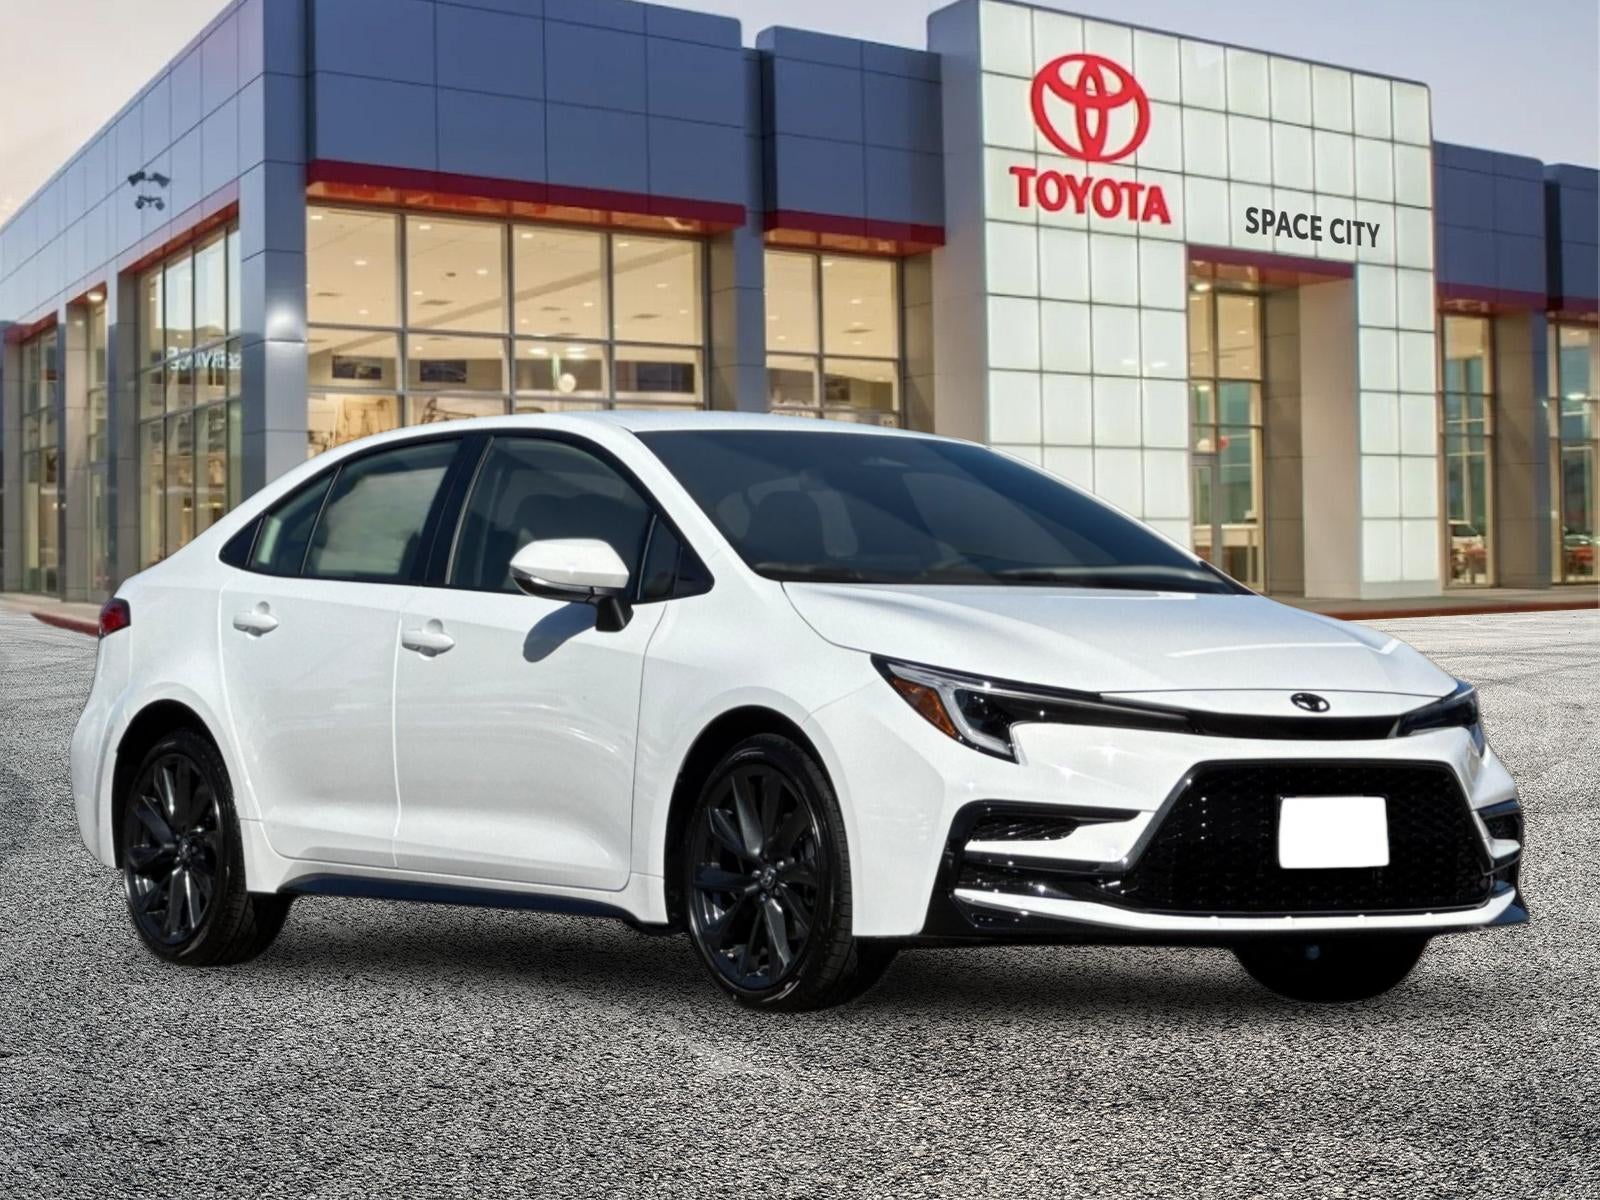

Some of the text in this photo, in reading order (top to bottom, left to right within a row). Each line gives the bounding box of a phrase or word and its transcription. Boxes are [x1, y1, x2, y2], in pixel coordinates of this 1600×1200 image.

[1009, 166, 1171, 224] TOYOTA
[1245, 206, 1380, 247] SPACE CITY
